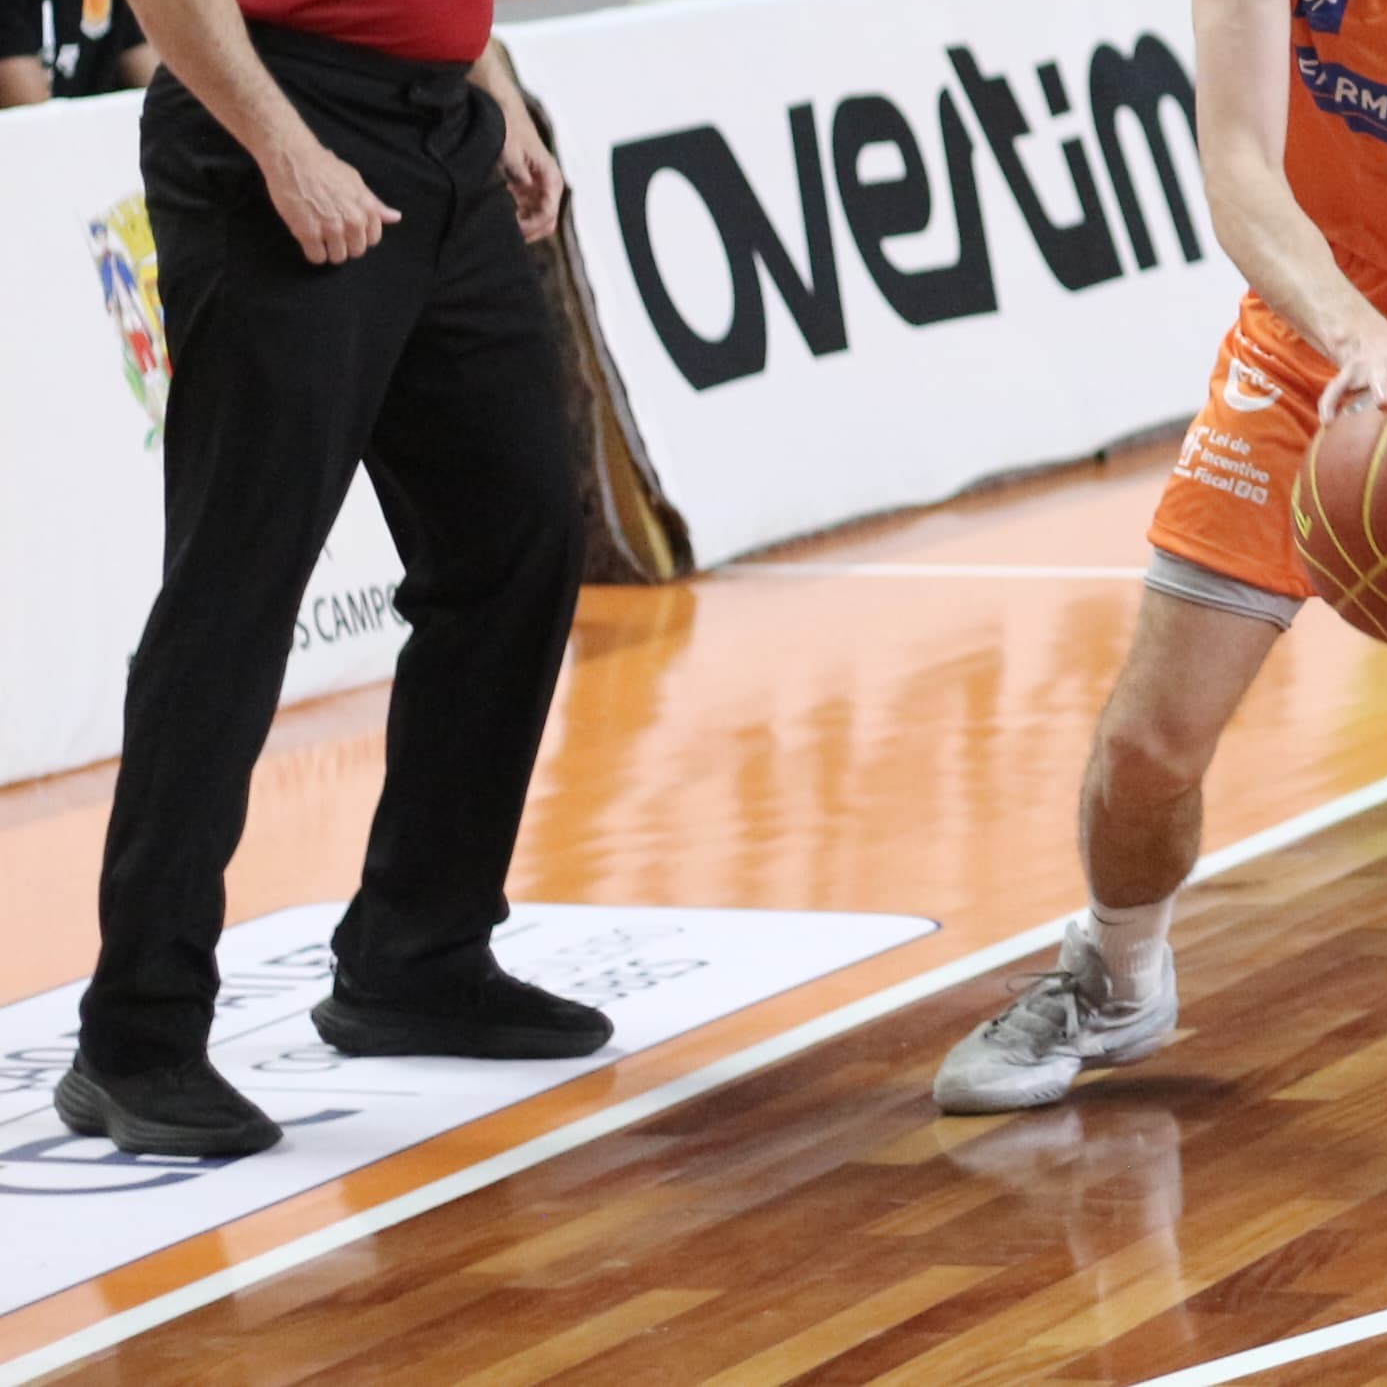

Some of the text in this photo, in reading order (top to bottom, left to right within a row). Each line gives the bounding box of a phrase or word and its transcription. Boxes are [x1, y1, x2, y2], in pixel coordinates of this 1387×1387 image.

[1208, 428, 1252, 456] Lei de
[1193, 466, 1235, 495] Fiscal
[1200, 448, 1270, 484] Incentivo
